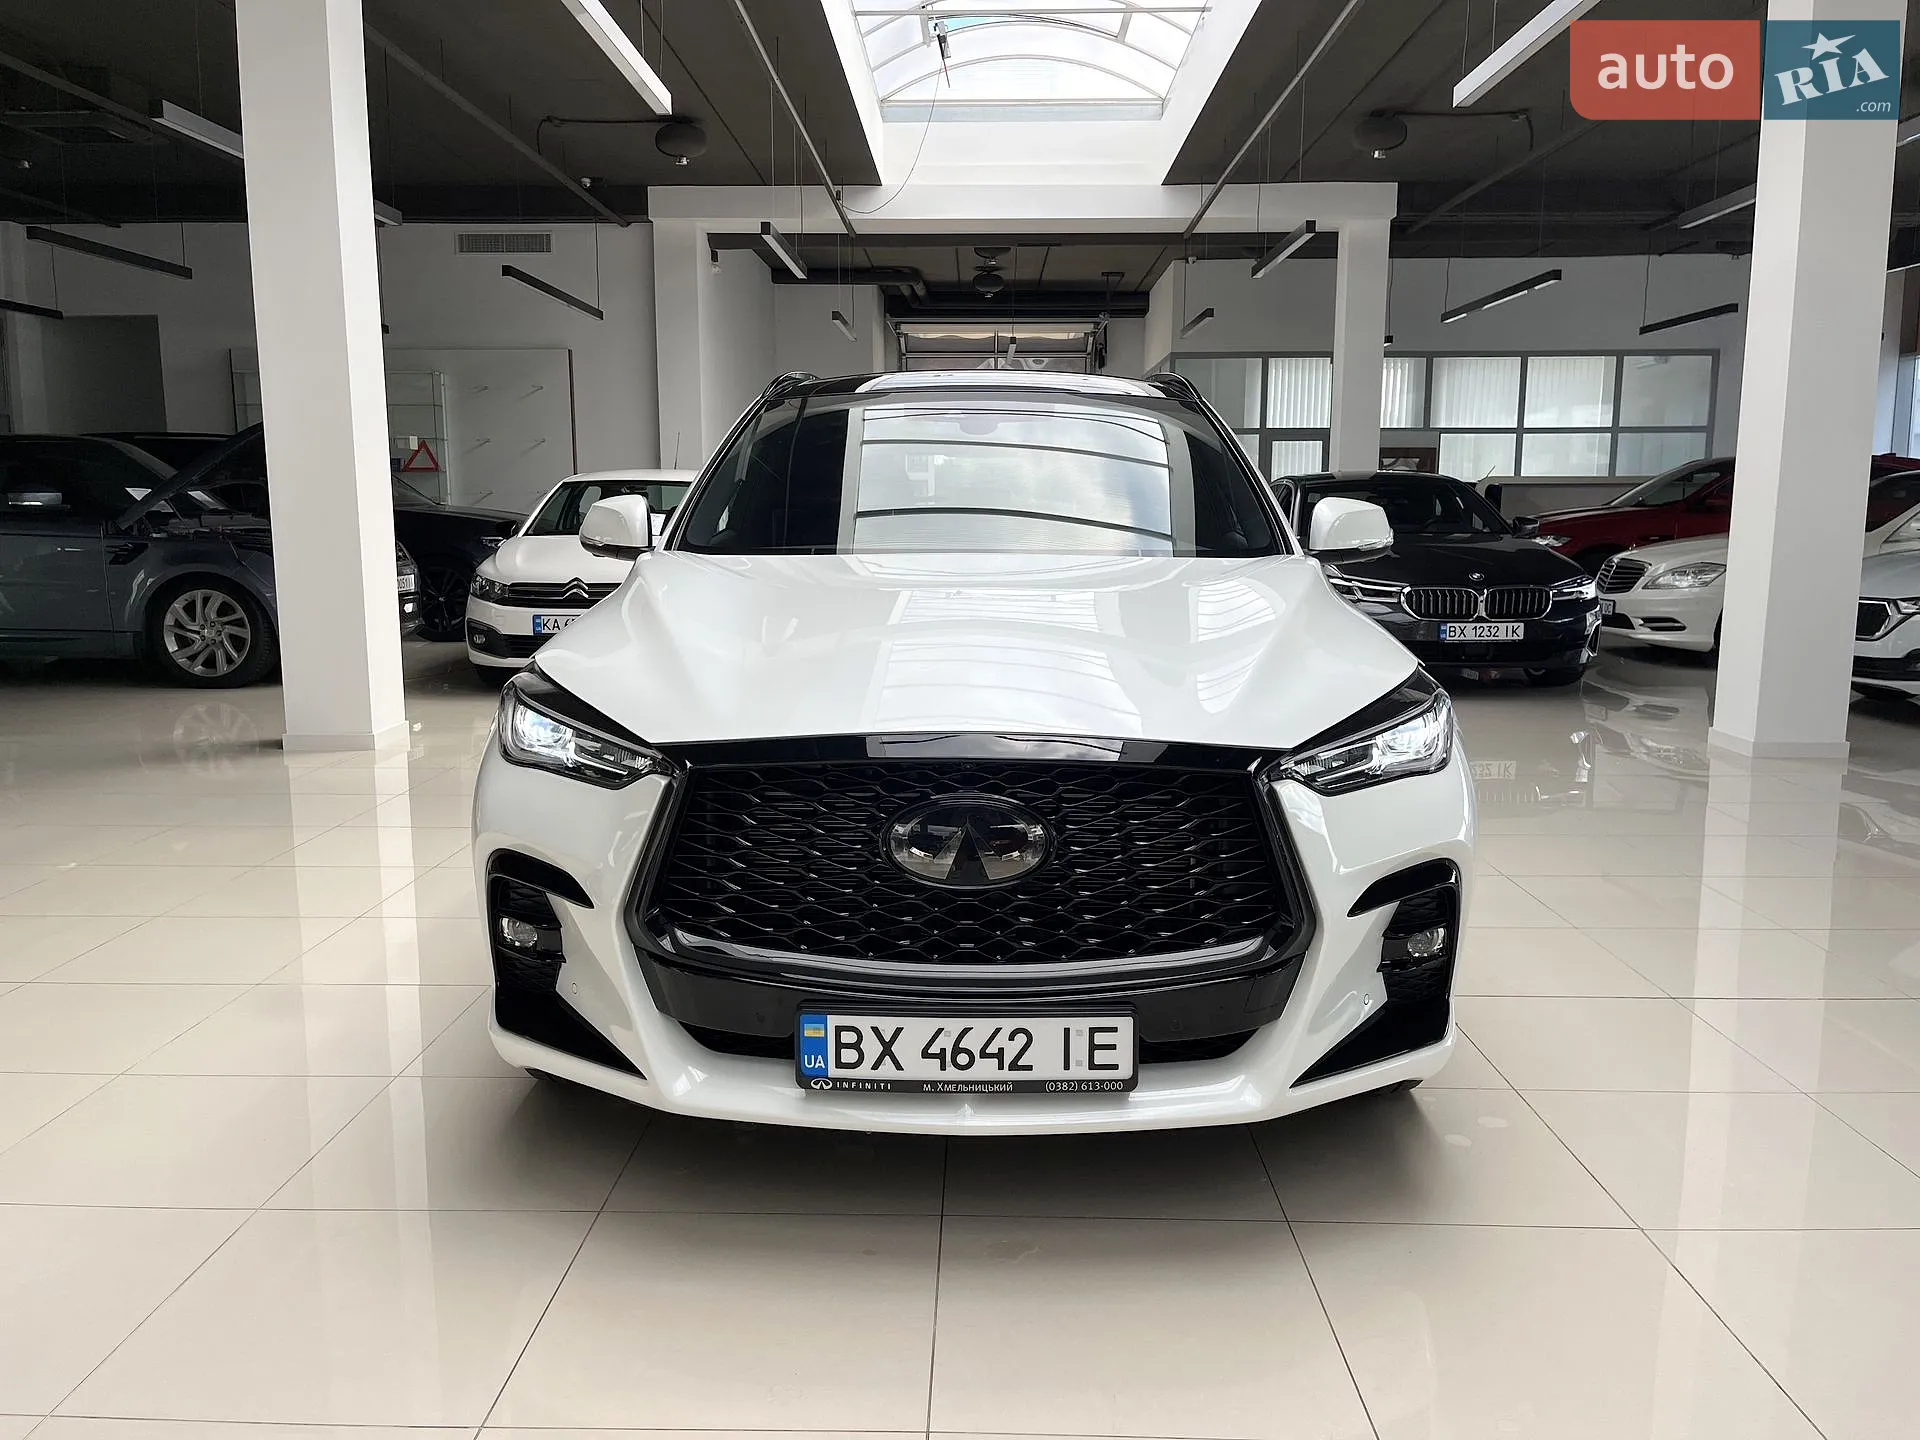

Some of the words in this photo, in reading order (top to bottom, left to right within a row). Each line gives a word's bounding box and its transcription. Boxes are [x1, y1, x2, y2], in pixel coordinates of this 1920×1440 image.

[542, 618, 561, 631] KA
[1448, 625, 1467, 638] BX
[1472, 625, 1500, 638] 1232
[1505, 625, 1520, 638] IK
[834, 1025, 904, 1072] BX
[920, 1026, 1033, 1072] 4642
[1063, 1027, 1119, 1072] IE
[804, 1054, 826, 1070] UA
[836, 1081, 891, 1090] INFINITI
[1045, 1081, 1077, 1093] (0382)
[1081, 1081, 1124, 1091] 613-000
